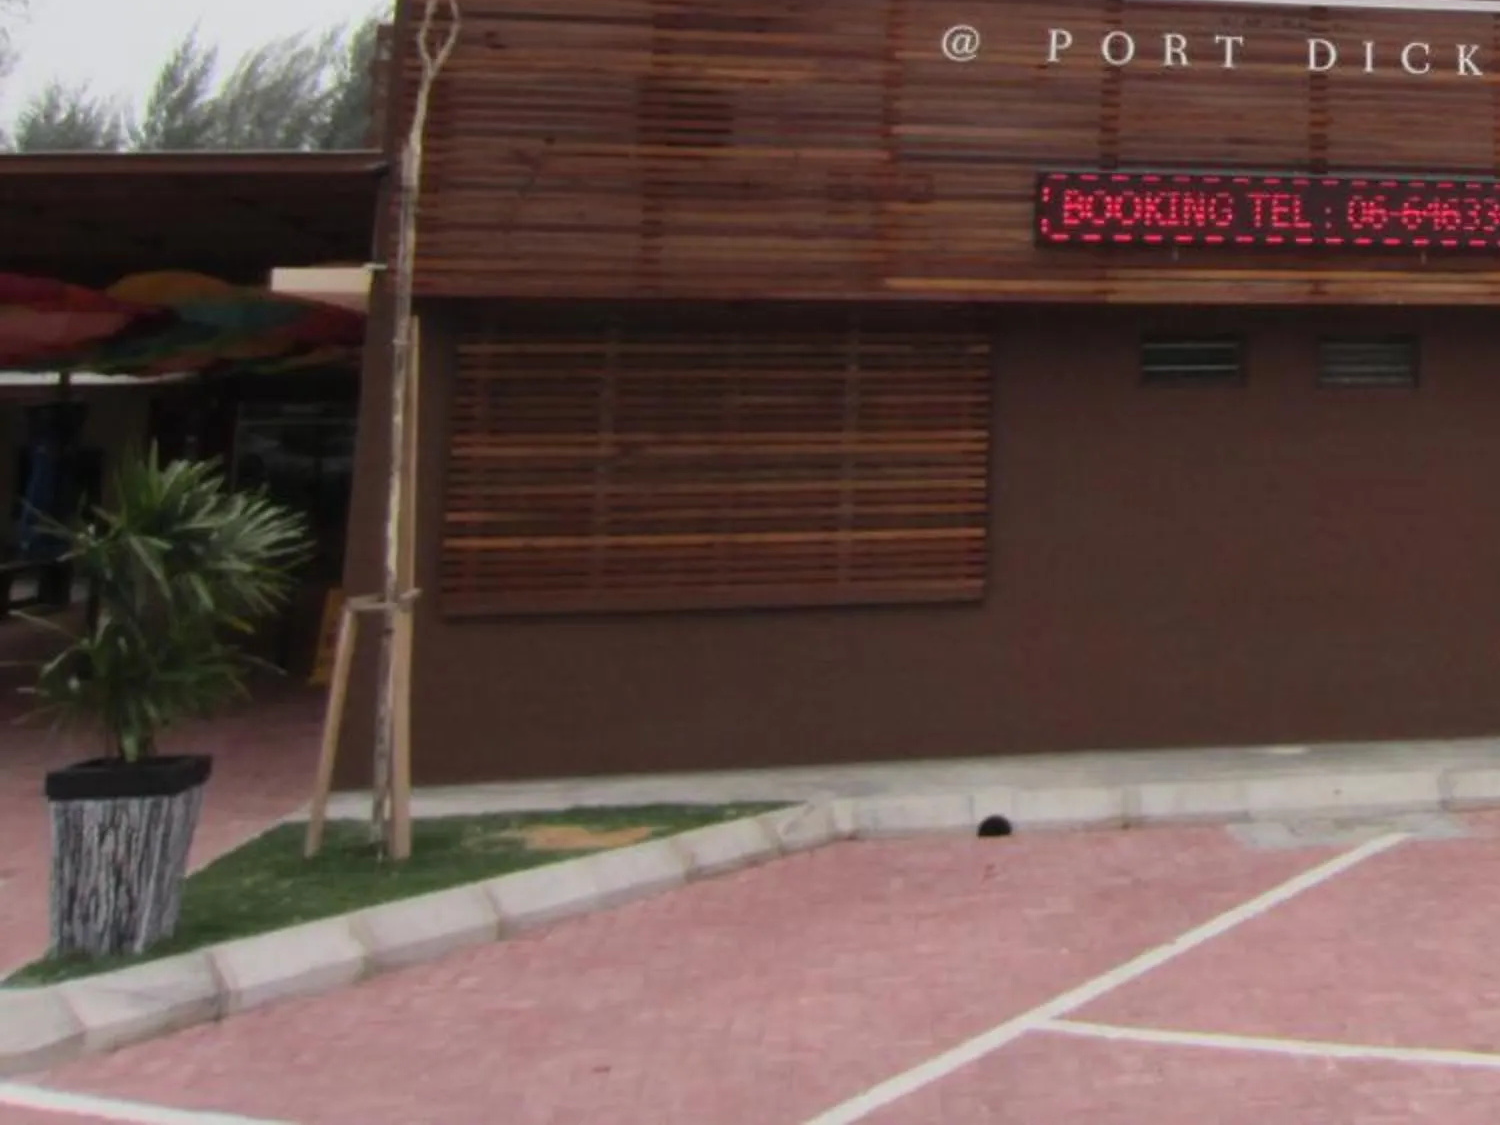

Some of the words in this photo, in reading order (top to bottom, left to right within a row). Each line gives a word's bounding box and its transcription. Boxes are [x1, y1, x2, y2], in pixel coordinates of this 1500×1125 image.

[941, 24, 981, 62] @
[1046, 28, 1244, 68] PORT
[1063, 189, 1235, 226] BOOKING
